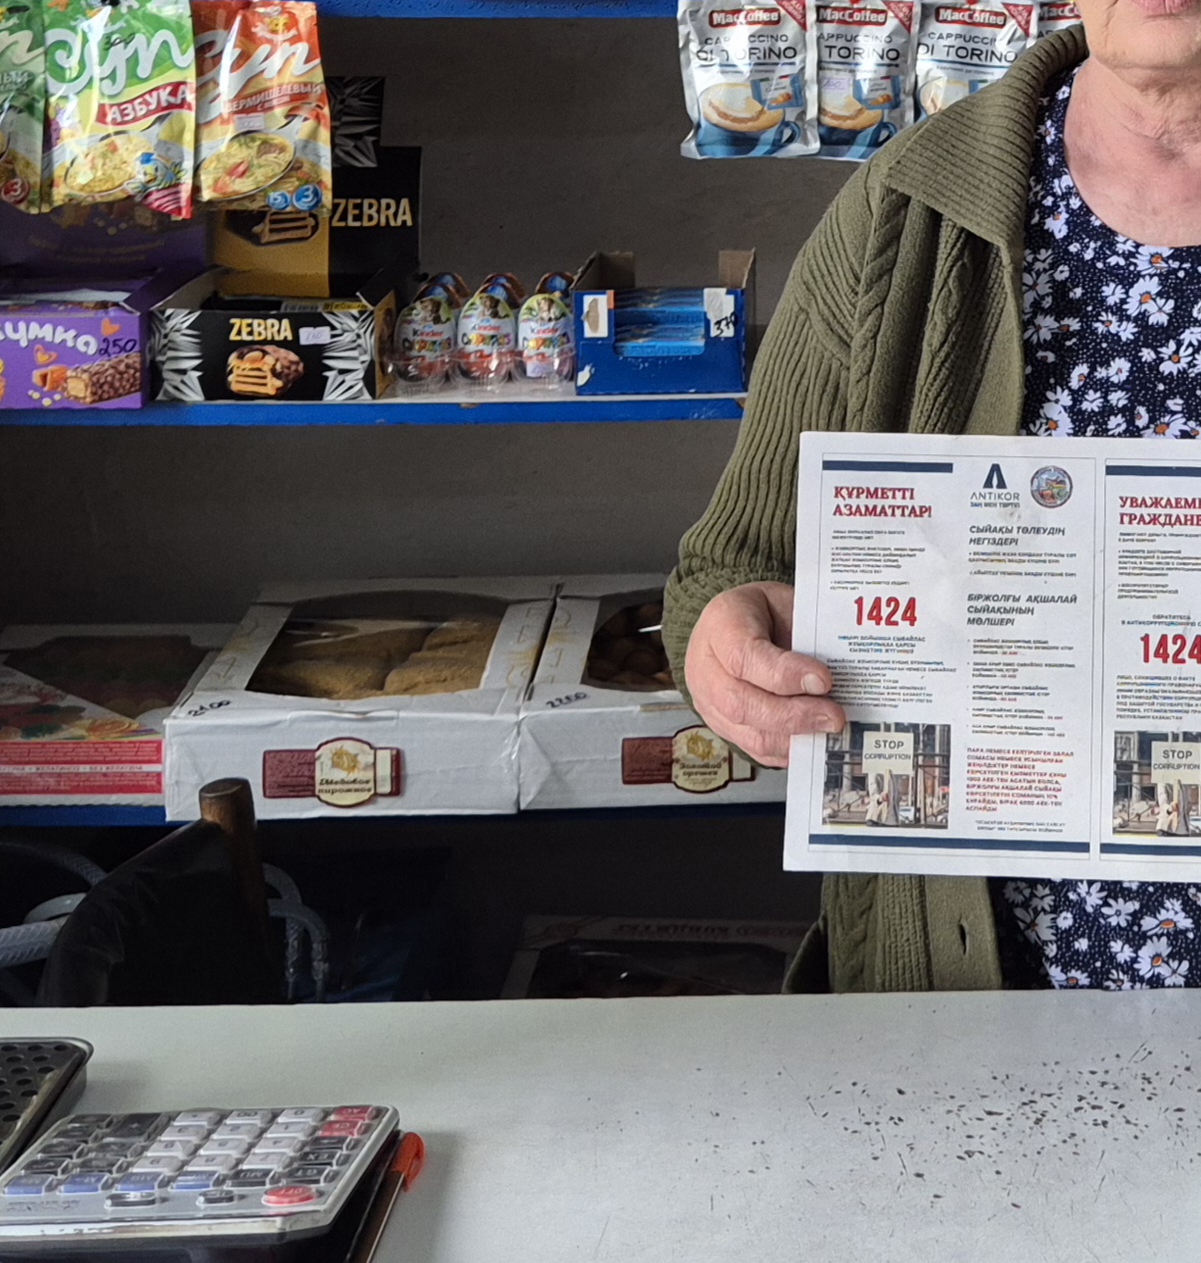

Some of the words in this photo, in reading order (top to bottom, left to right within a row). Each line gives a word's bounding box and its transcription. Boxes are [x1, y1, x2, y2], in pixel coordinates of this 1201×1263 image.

[711, 9, 780, 26] MacCoffee
[818, 8, 888, 25] MacCoffee
[939, 8, 1006, 26] MacCoffee
[824, 44, 900, 61] TORINO
[942, 43, 1018, 64] TORINO
[106, 85, 191, 124] АЗБУКА
[332, 197, 413, 228] ZEBRA
[228, 318, 294, 343] ZEBRA
[832, 504, 933, 519] АЗАМАТТАР!
[854, 595, 917, 627] 1424
[873, 739, 905, 750] STOP
[1162, 749, 1193, 760] STOP
